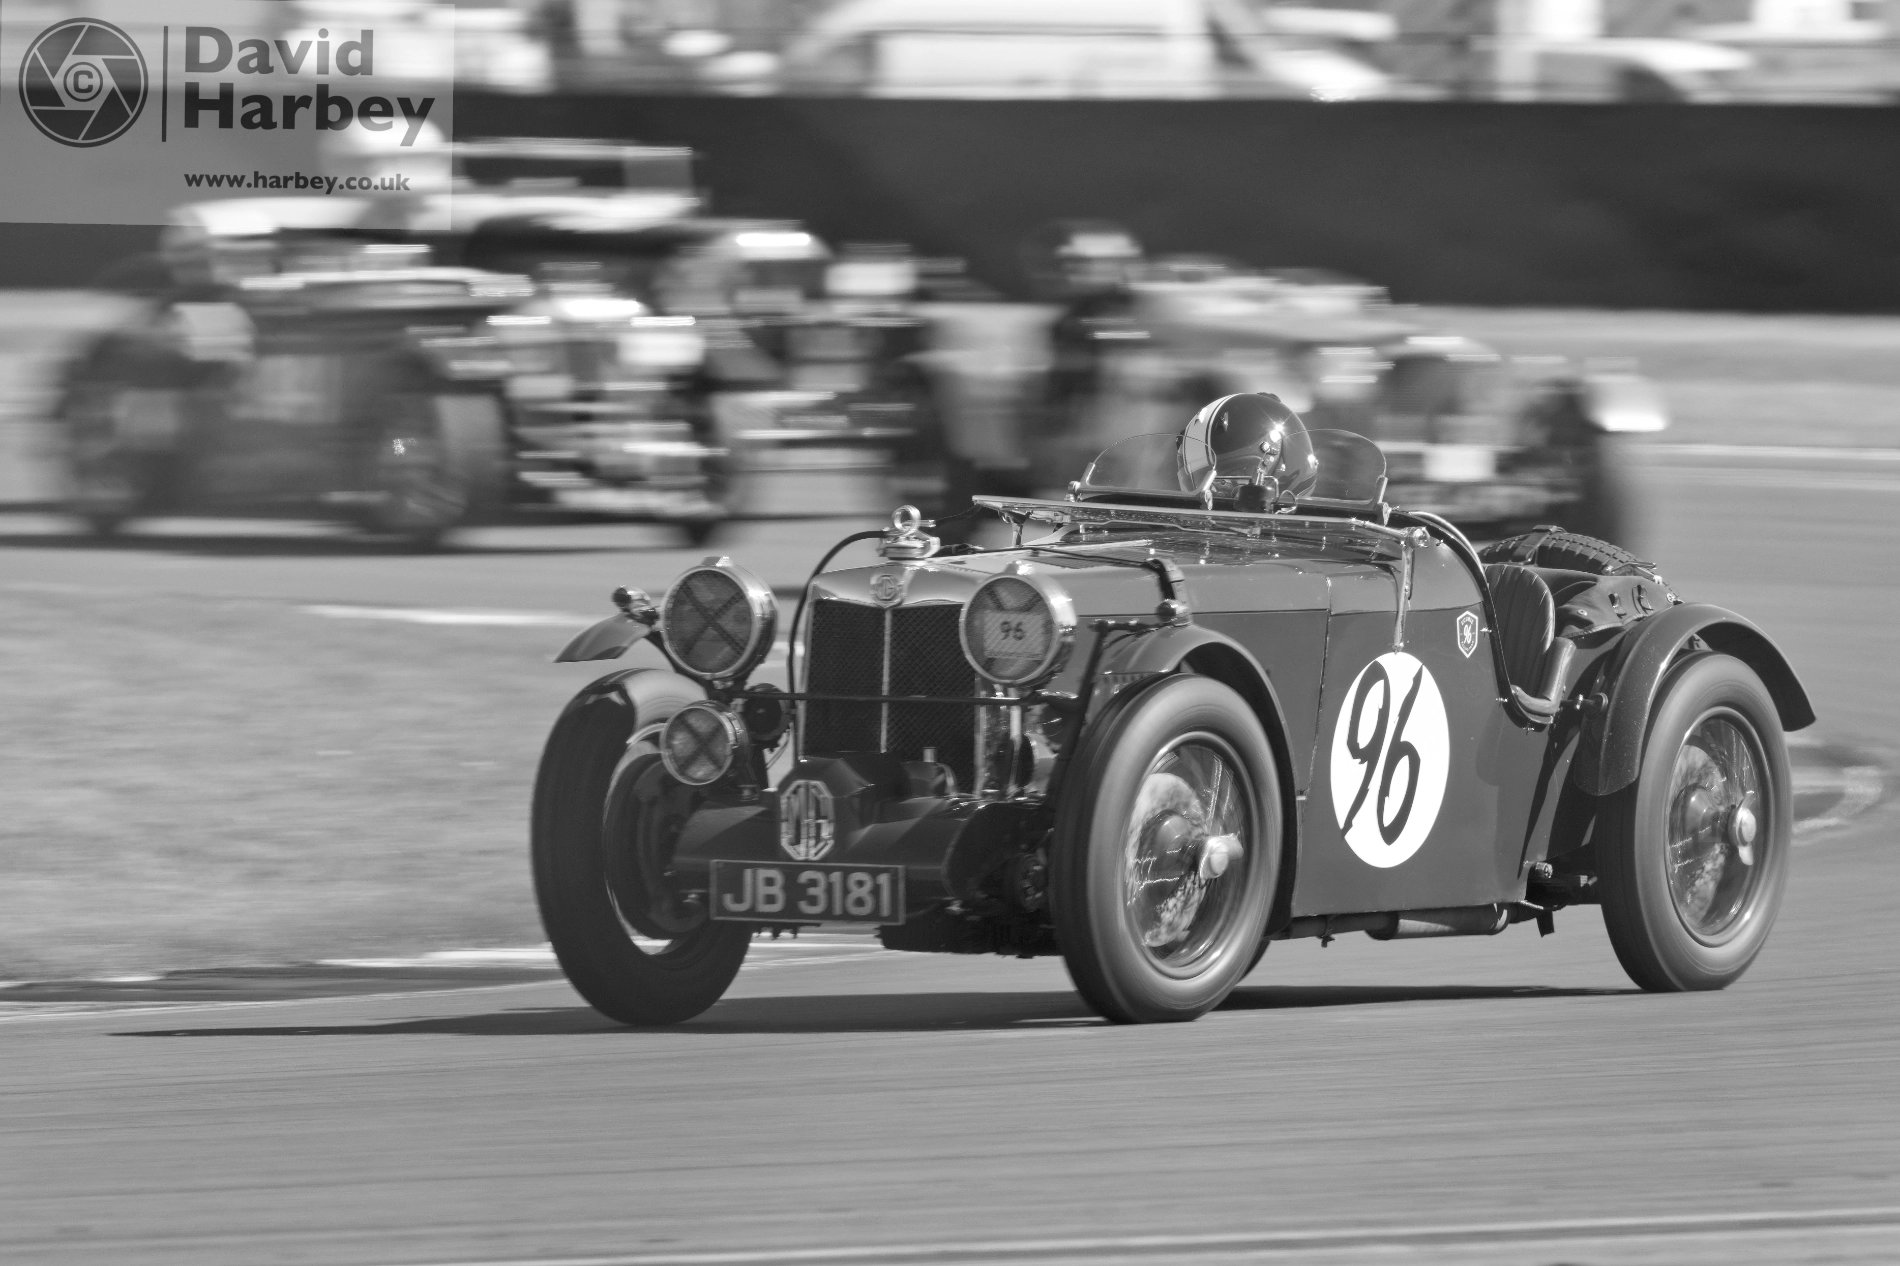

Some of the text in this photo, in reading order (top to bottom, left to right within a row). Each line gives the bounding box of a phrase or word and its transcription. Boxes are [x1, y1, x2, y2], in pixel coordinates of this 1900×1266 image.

[1000, 620, 1026, 641] 96
[1341, 659, 1424, 847] 96
[780, 779, 835, 861] MG
[721, 868, 893, 918] JB 3181
